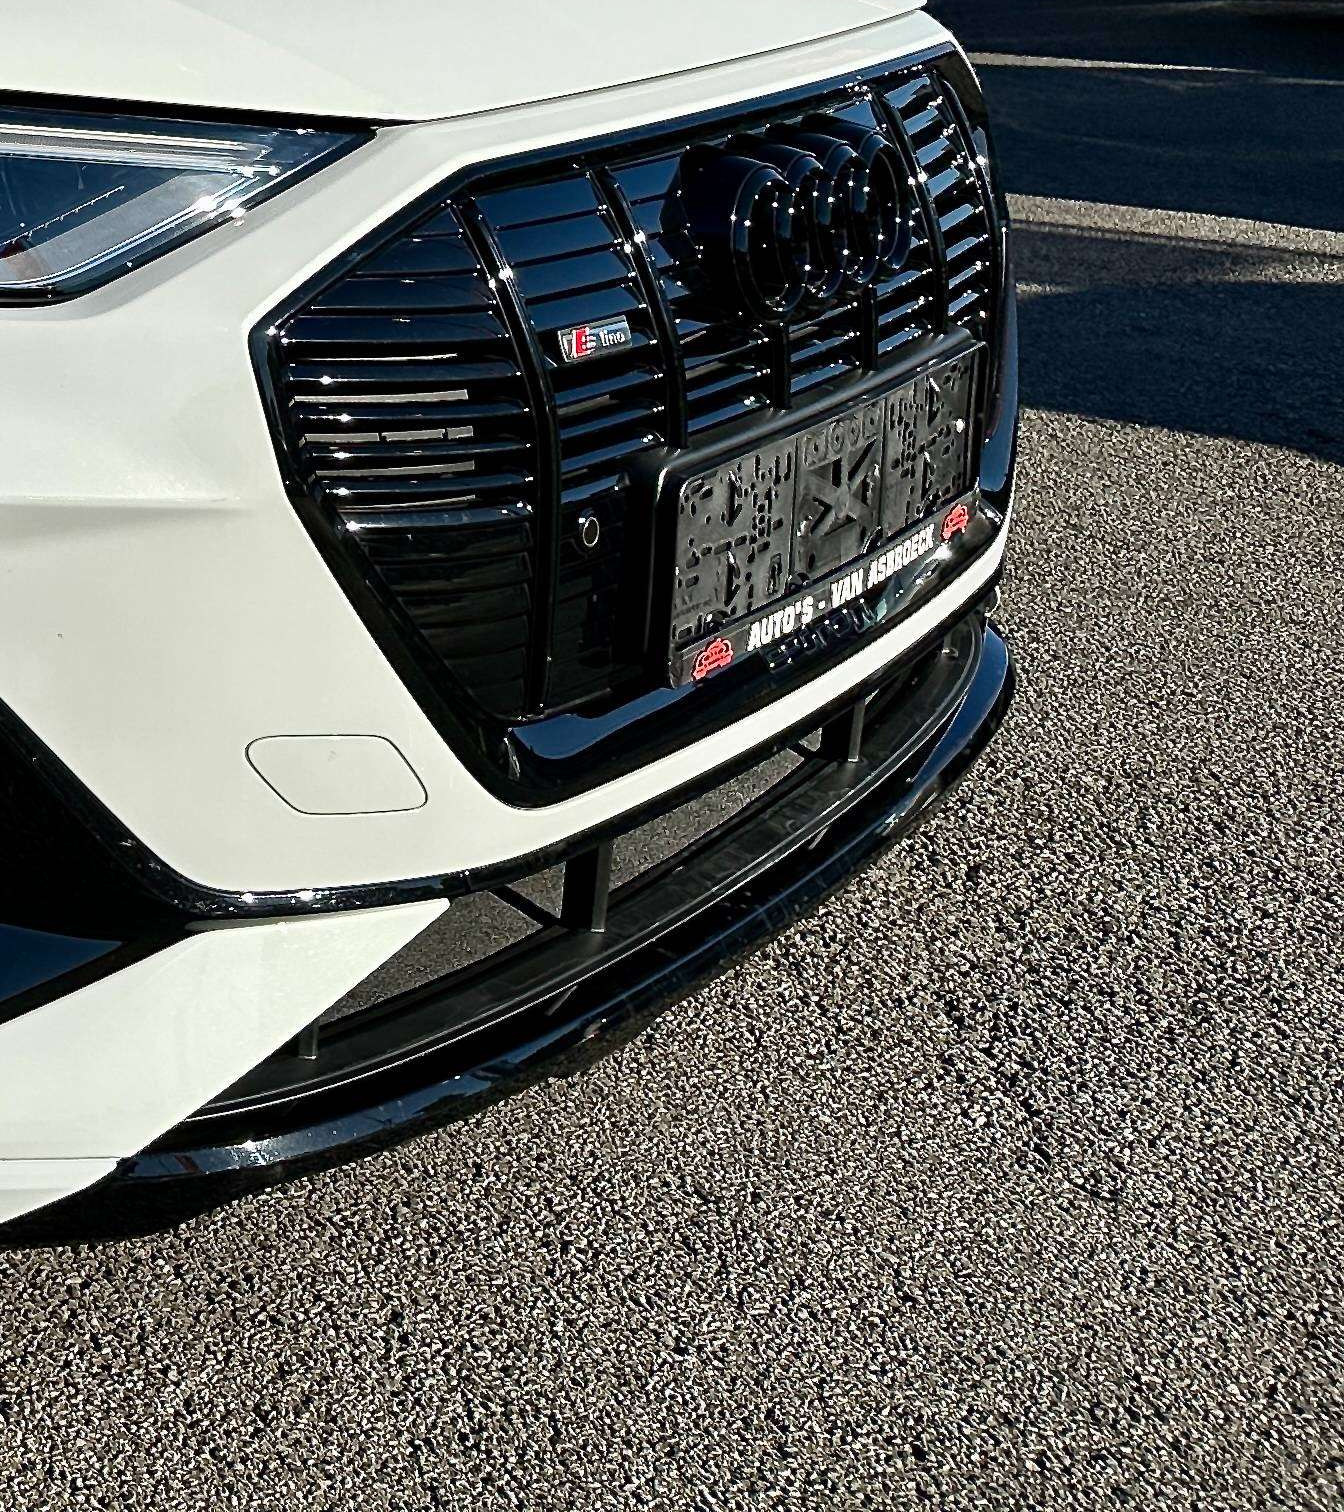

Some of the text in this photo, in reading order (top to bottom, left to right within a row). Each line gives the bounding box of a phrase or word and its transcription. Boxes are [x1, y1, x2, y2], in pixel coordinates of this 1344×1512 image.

[747, 595, 814, 652] AUTO'S
[829, 568, 864, 609] VAN
[866, 523, 936, 589] ASBROECK
